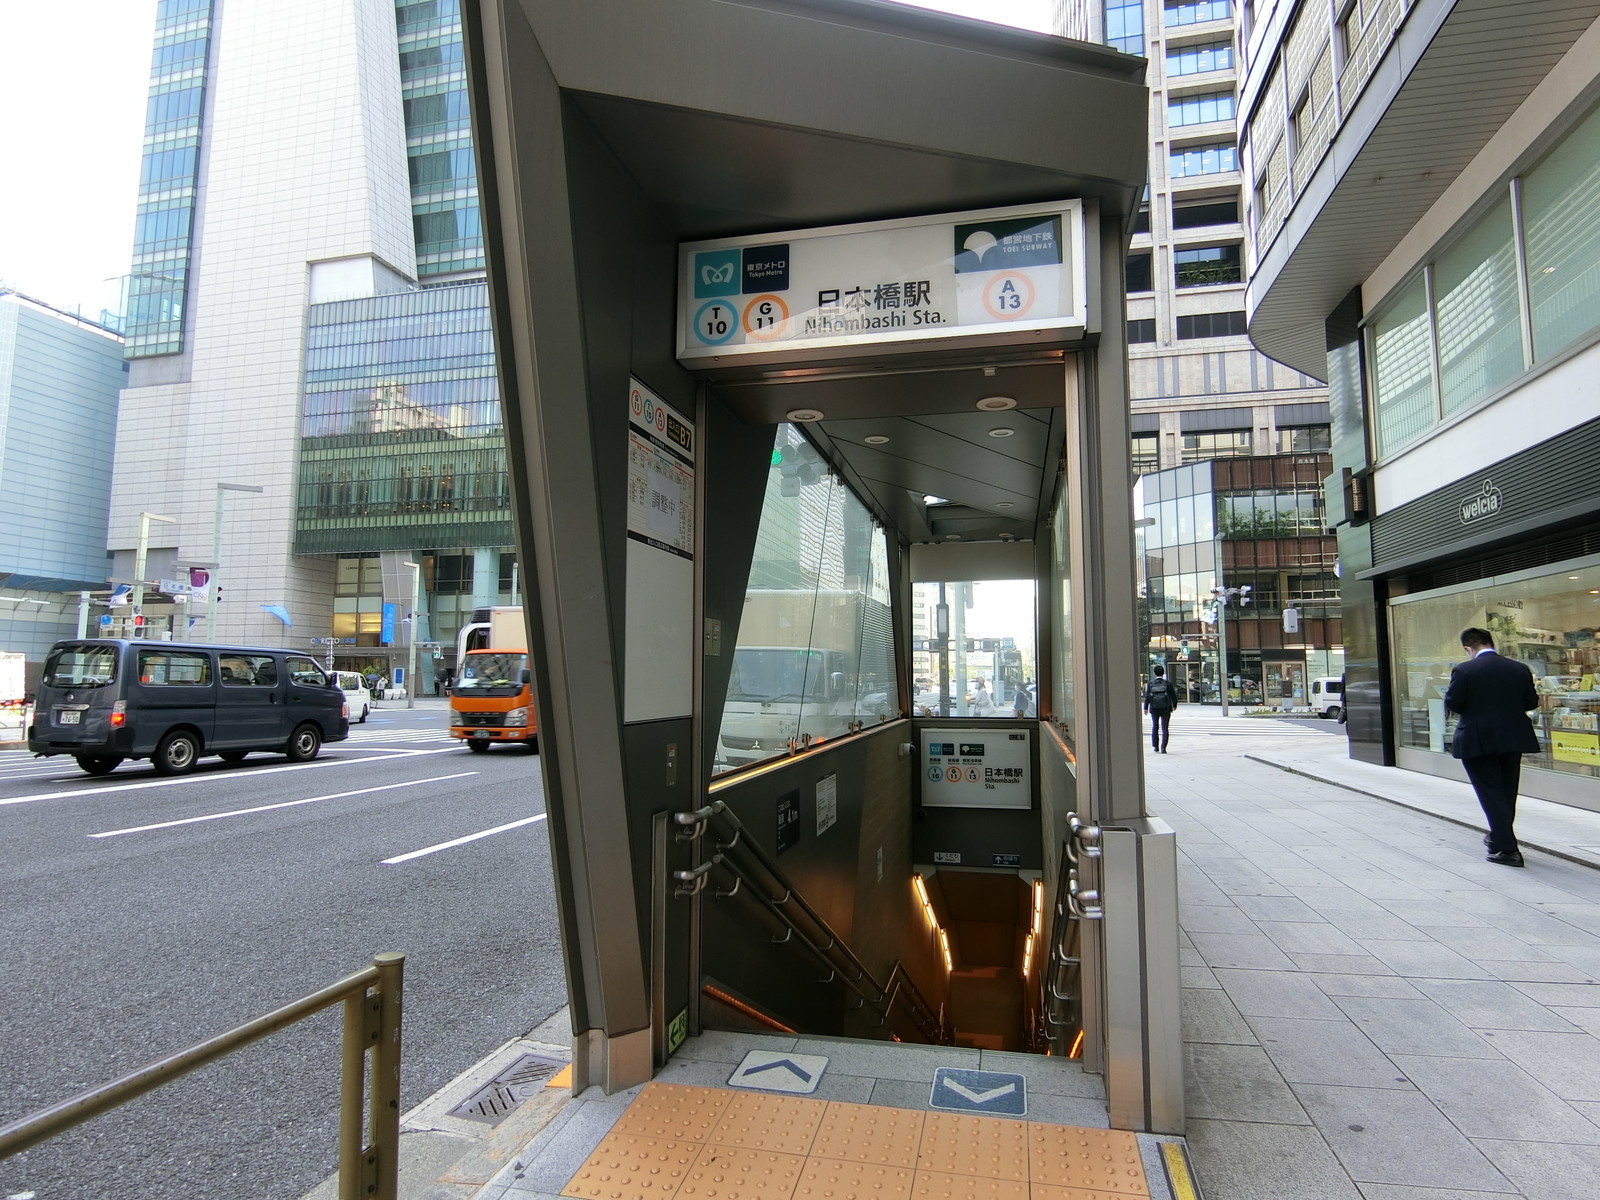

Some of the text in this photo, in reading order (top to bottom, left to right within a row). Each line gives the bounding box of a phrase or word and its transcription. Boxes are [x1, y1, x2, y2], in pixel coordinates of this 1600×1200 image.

[1003, 232, 1052, 245] 都営地下鉄
[1022, 242, 1053, 252] SUBWAY
[747, 260, 786, 272] 東京メトロ
[766, 269, 783, 277] Metro
[1002, 280, 1015, 293] A
[818, 281, 931, 315] 日本橋駅
[998, 294, 1021, 310] 13
[712, 307, 721, 319] T
[759, 302, 772, 315] G
[707, 321, 727, 335] 10
[756, 316, 774, 330] 11
[805, 309, 946, 334] Nihombashi Sta.
[680, 426, 691, 448] B7
[652, 490, 676, 516] 調整中
[1462, 495, 1498, 519] welcia
[984, 768, 1023, 777] 日本橋駅
